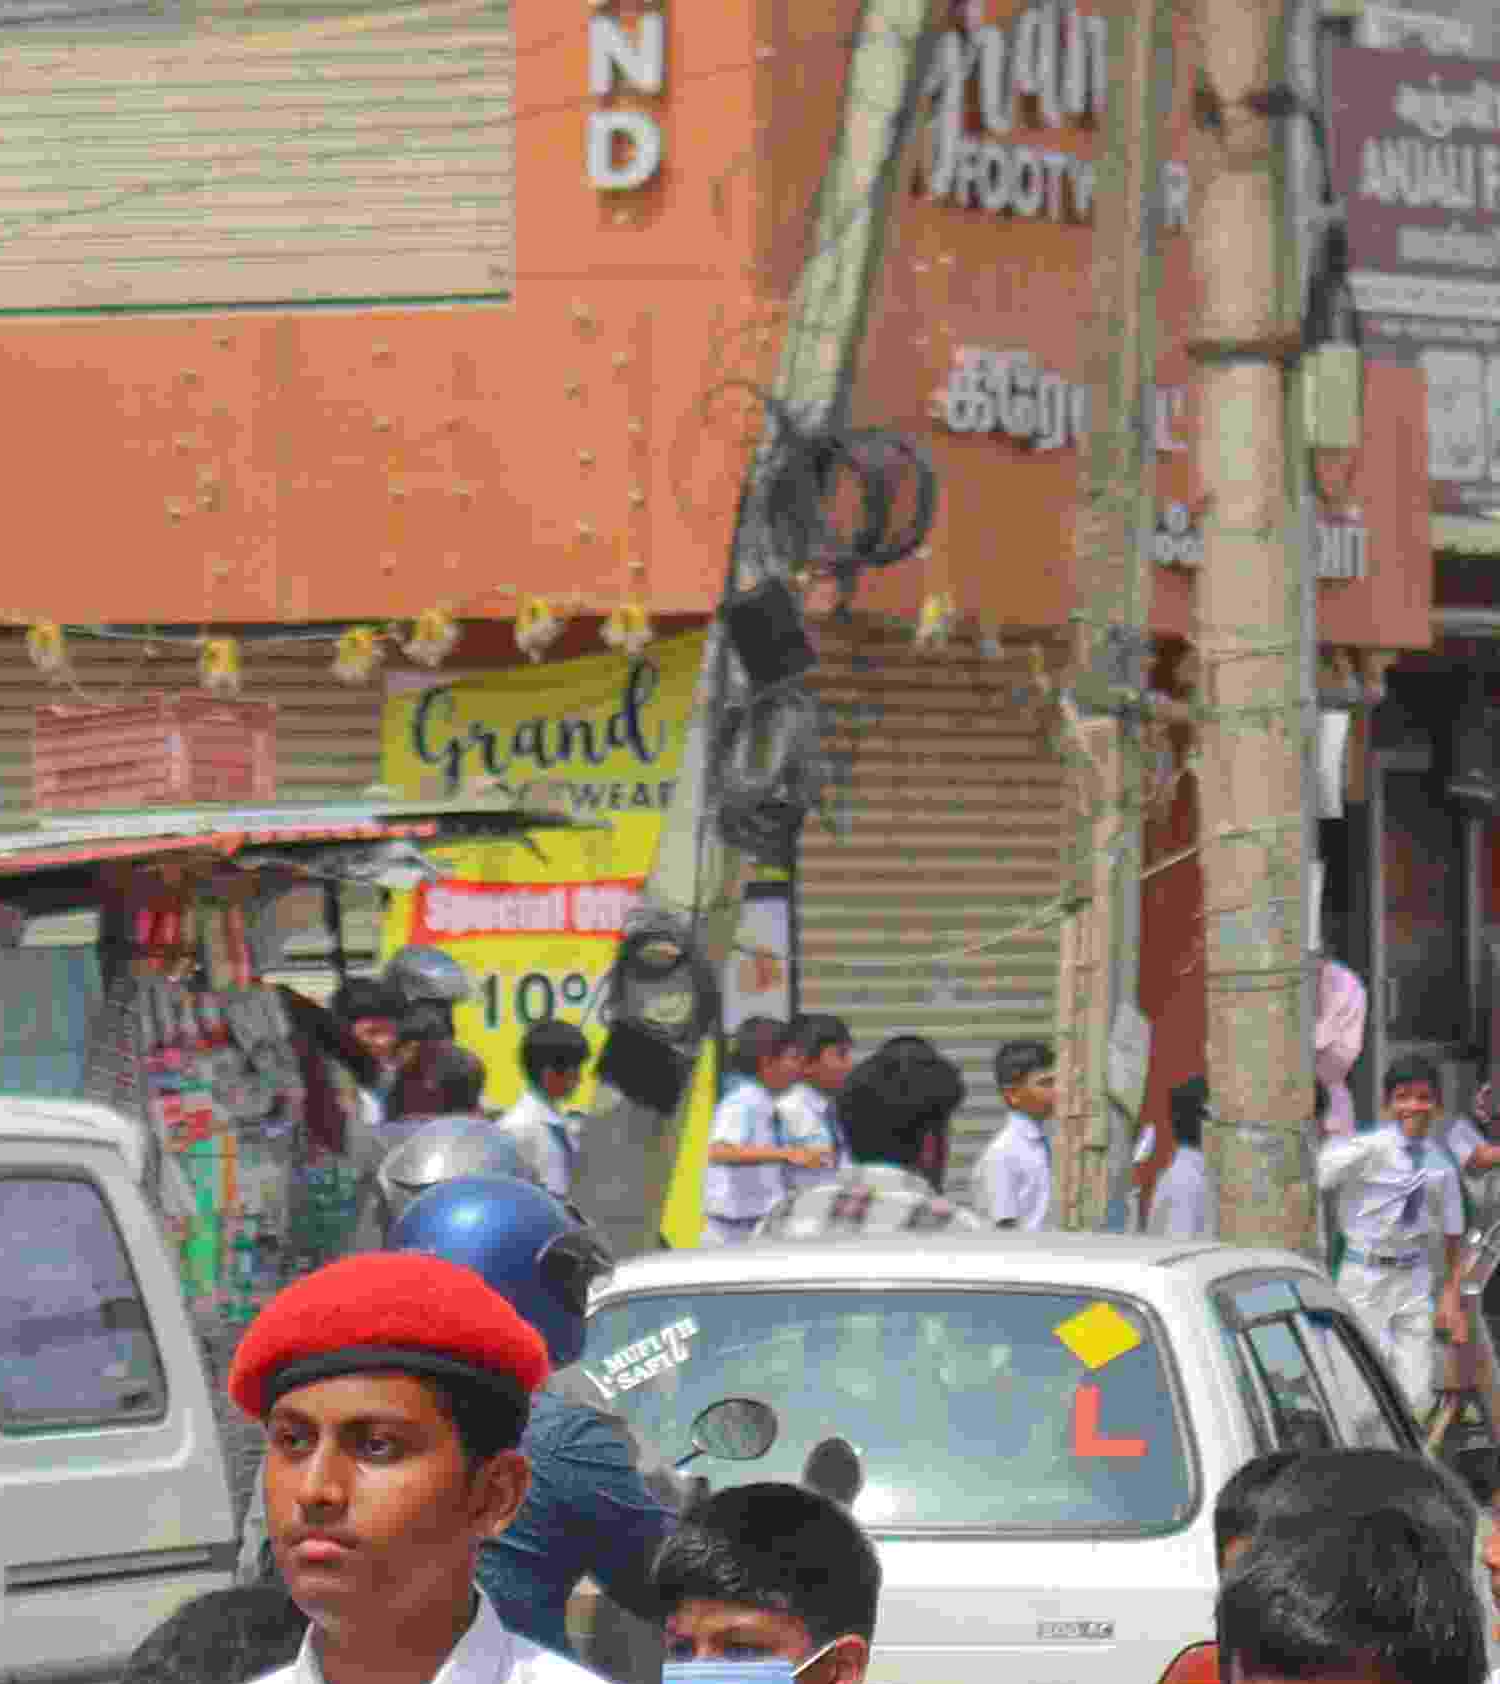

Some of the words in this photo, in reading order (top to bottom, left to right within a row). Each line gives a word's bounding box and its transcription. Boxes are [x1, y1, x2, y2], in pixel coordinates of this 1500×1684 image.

[1359, 137, 1475, 210] ANJALI
[411, 656, 659, 797] Grand
[1073, 1384, 1147, 1457] L
